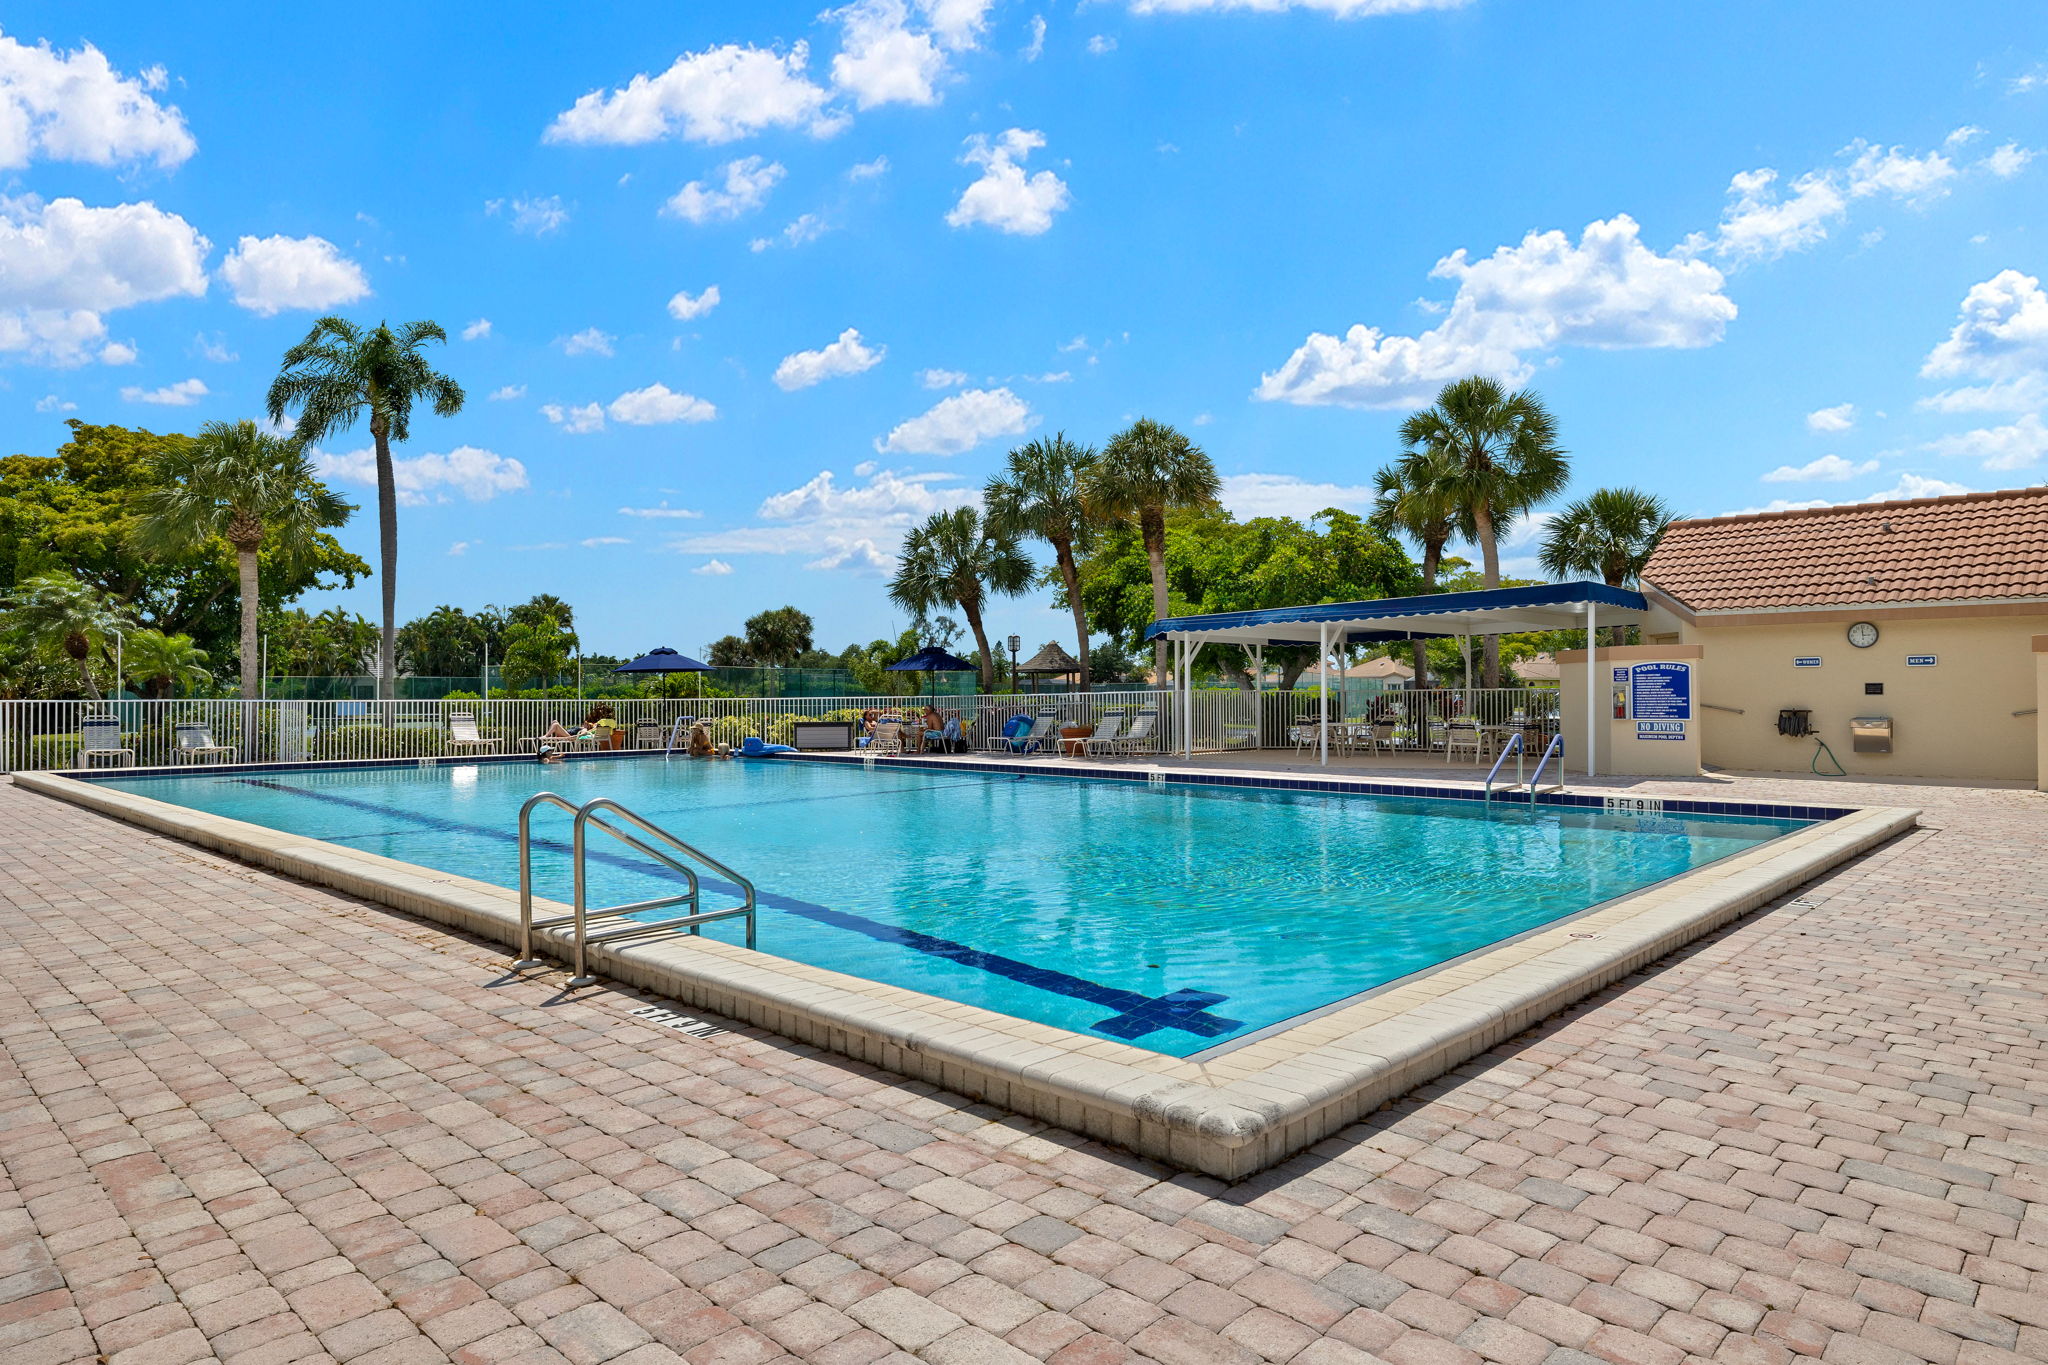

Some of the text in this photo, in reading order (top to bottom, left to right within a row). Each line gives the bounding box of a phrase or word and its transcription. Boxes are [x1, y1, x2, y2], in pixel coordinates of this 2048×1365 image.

[1635, 664, 1687, 673] POOL RULES
[1640, 722, 1681, 731] NO DIVING
[1157, 774, 1164, 782] FT
[1607, 798, 1661, 811] 5 FT 9 IN
[645, 1010, 688, 1023] FT
[671, 1019, 703, 1029] 9
[686, 1025, 727, 1038] IN
